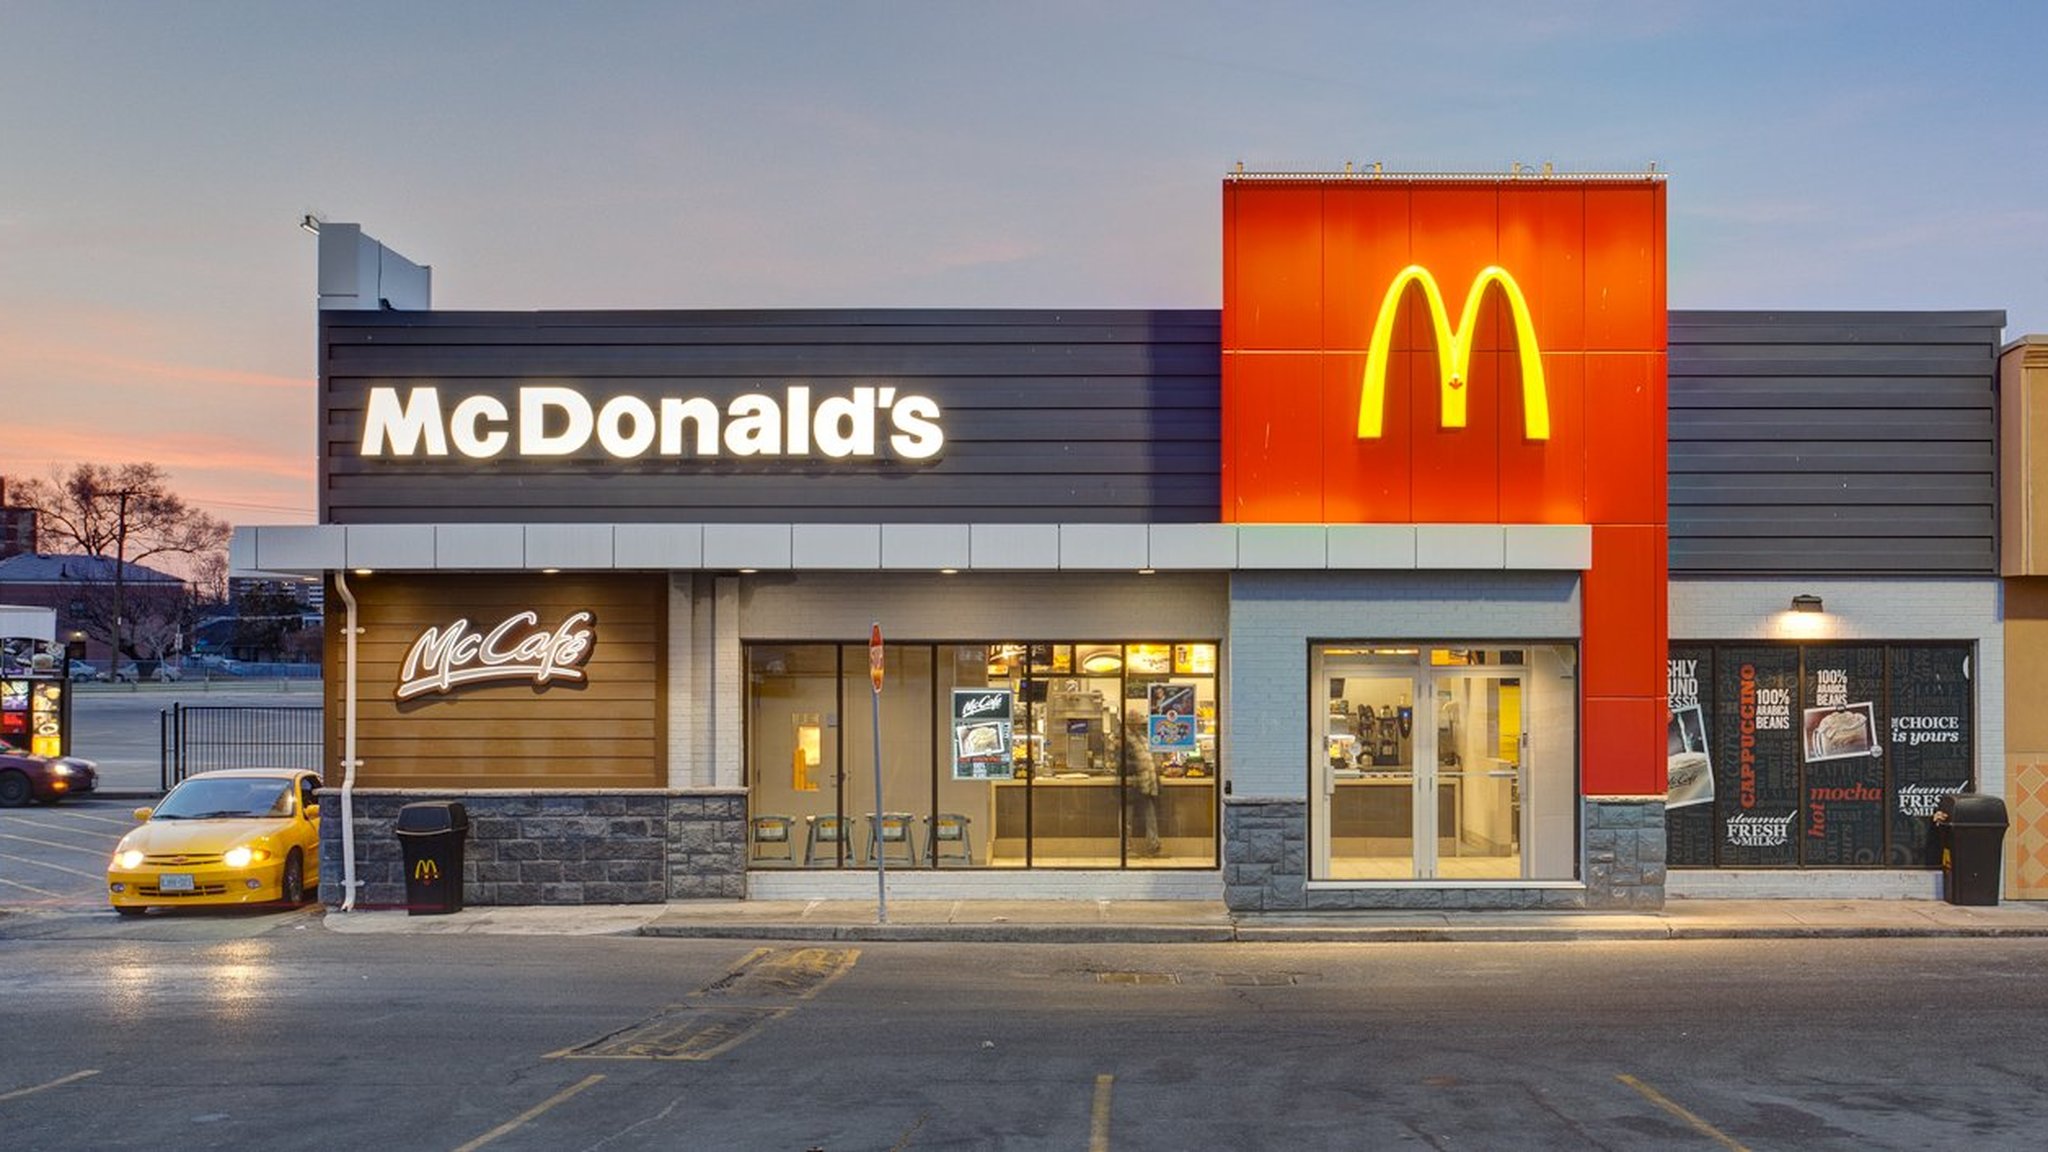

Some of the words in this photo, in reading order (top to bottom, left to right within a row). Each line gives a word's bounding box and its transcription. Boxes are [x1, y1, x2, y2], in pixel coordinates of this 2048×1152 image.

[360, 385, 945, 459] McDonald's
[399, 611, 591, 692] McCafé
[1817, 669, 1848, 684] 100%
[1756, 688, 1791, 705] 100%
[1816, 693, 1848, 706] BEANS
[1756, 705, 1790, 716] ARABICA
[1756, 716, 1790, 730] BEANS
[1899, 715, 1960, 730] CHOICE
[1740, 664, 1756, 809] CAPPUCCINO
[1892, 728, 1908, 742] is
[1910, 731, 1960, 746] yours
[1810, 781, 1883, 800] mocha
[1897, 780, 1969, 795] steamed
[1899, 794, 1943, 808] FRES
[1725, 809, 1798, 824] steamed
[1808, 802, 1826, 840] hot
[1727, 824, 1788, 838] FRESH
[1740, 837, 1777, 847] MILK
